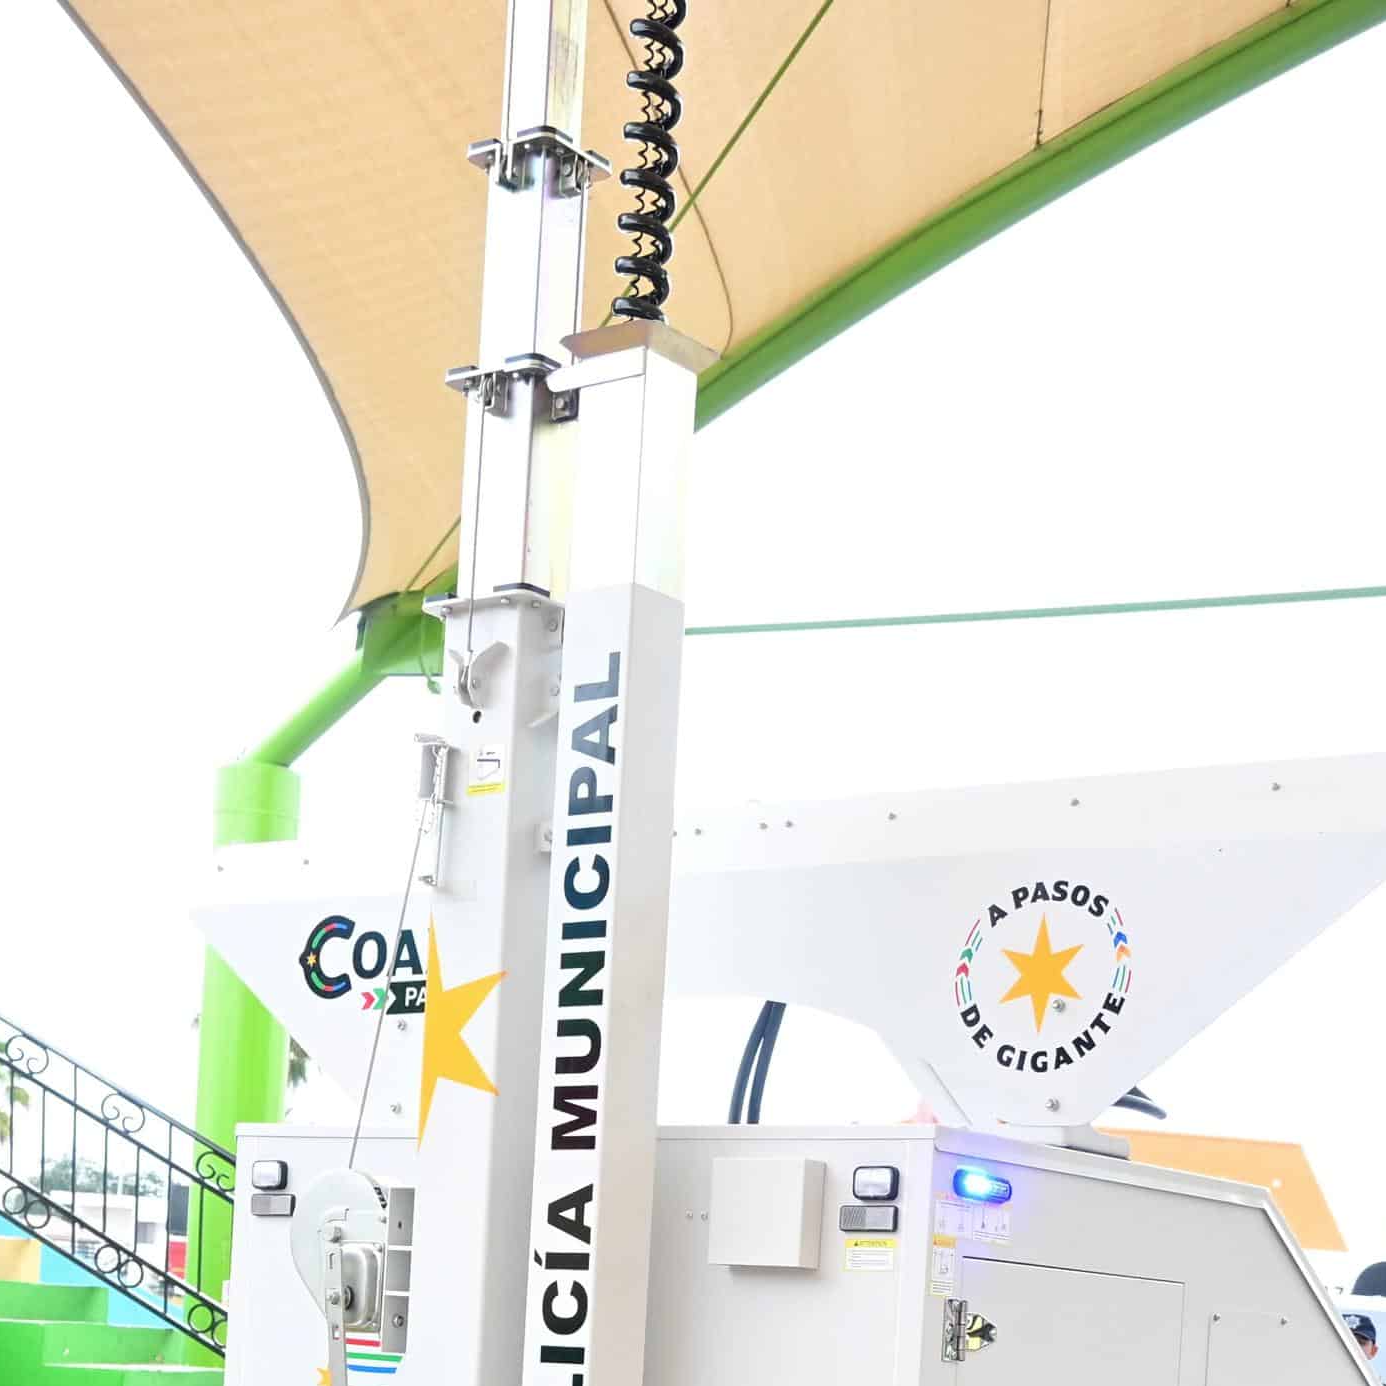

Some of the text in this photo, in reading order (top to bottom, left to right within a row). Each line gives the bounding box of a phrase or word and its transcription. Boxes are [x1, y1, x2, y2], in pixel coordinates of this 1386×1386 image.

[550, 651, 622, 1150] MUNICIPAL
[986, 880, 1110, 927] A PASOS
[959, 992, 1125, 1073] DE GIGANTE
